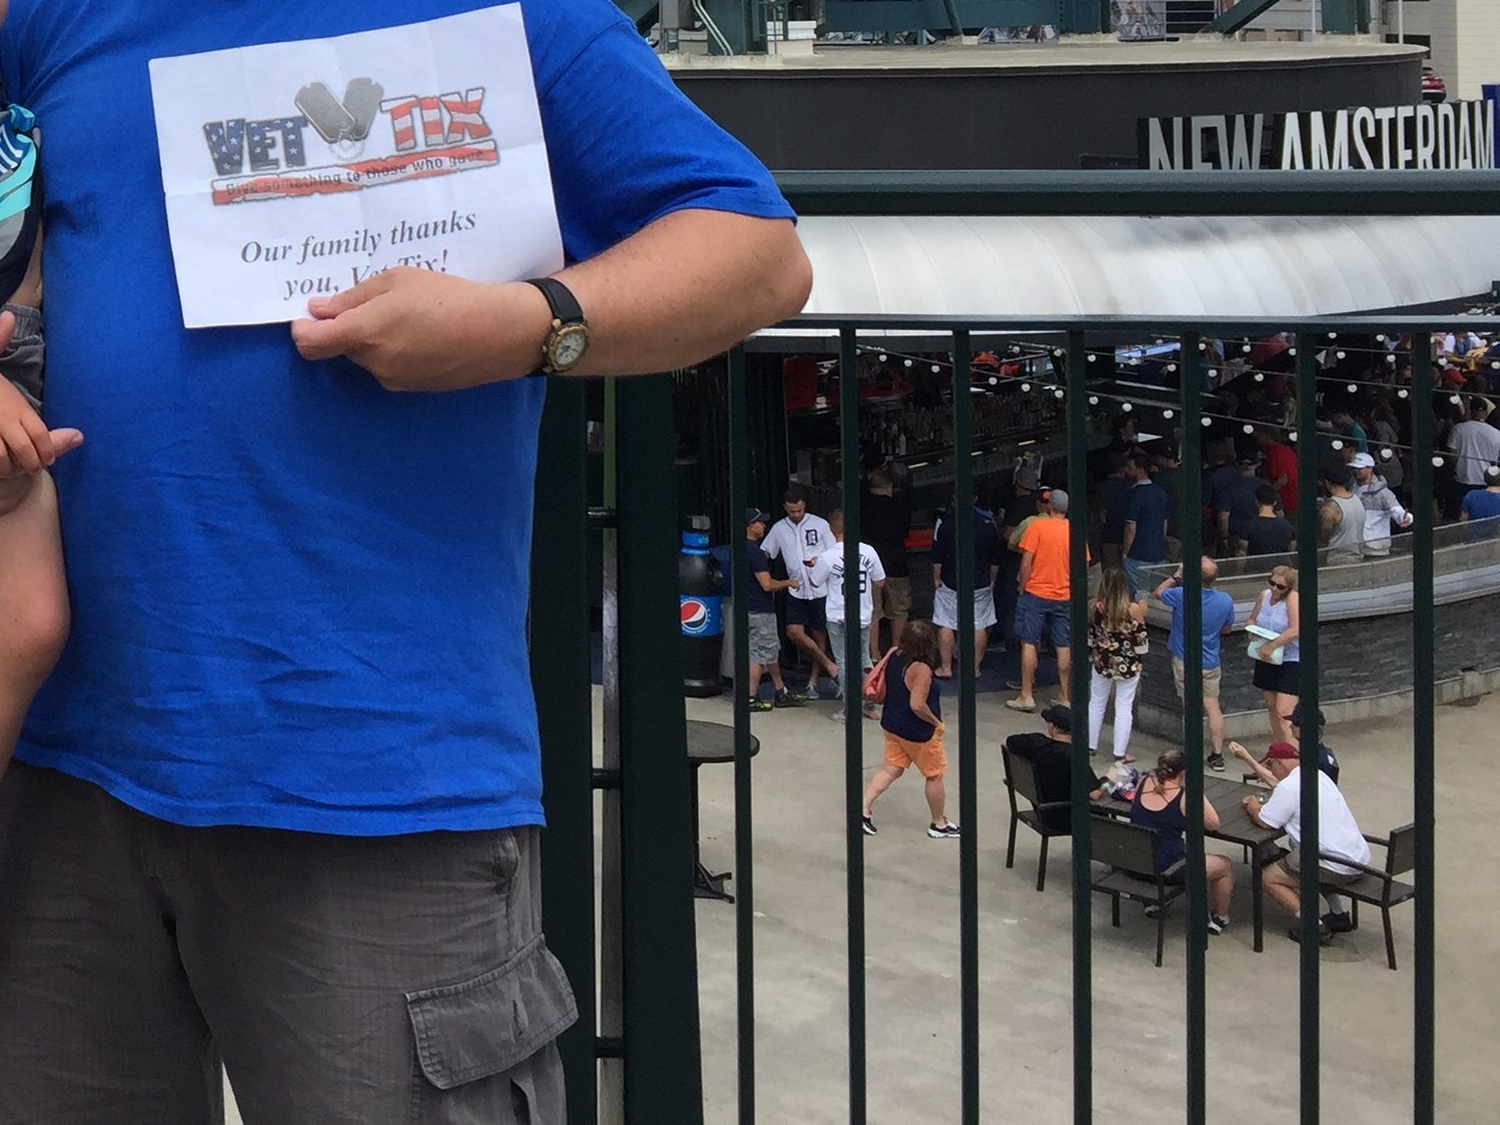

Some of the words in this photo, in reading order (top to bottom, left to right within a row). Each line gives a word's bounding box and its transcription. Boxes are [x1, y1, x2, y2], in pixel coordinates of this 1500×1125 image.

[202, 116, 308, 176] VET
[380, 87, 493, 153] TIX
[1281, 99, 1495, 170] AMSTERDAM
[226, 182, 258, 195] Give
[264, 175, 342, 192] something
[347, 169, 361, 183] to
[365, 162, 407, 179] those
[412, 156, 443, 171] who
[449, 150, 484, 168] gave
[240, 241, 292, 263] Our
[297, 228, 382, 265] family
[390, 210, 477, 246] thanks
[283, 275, 340, 301] you,
